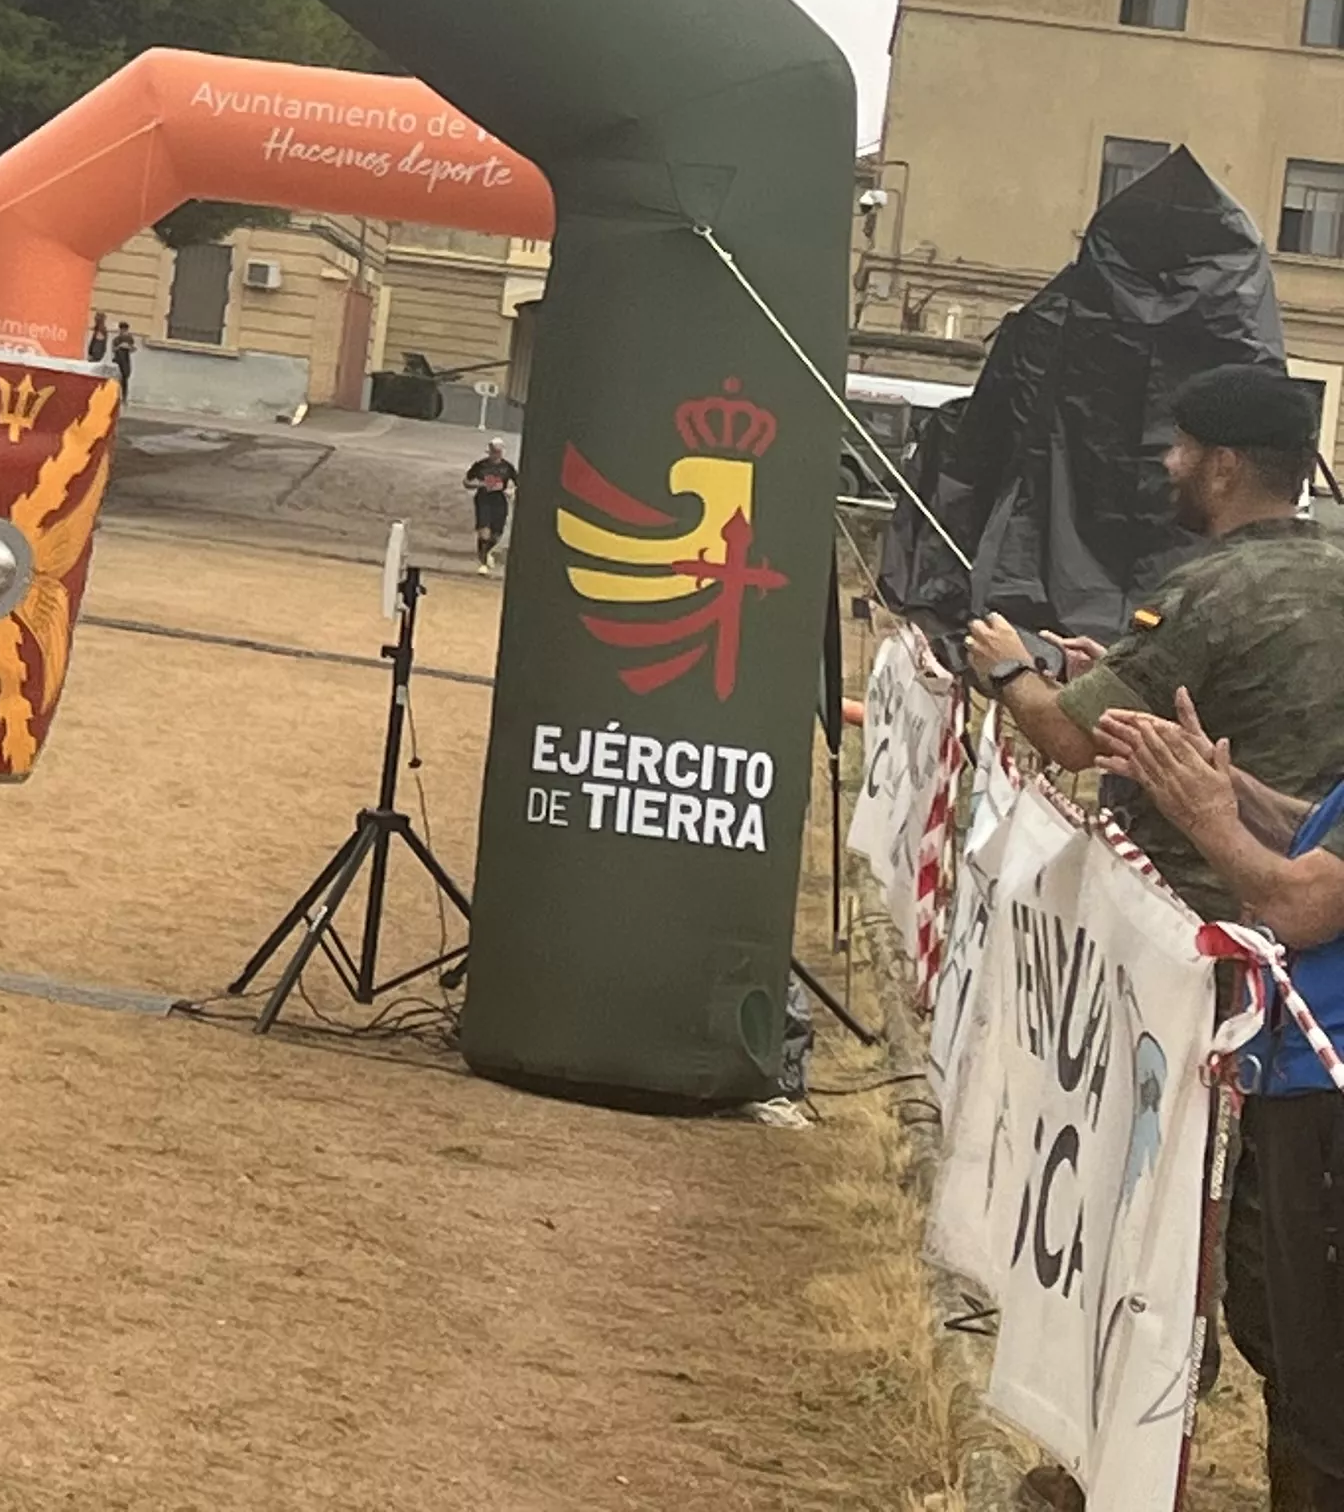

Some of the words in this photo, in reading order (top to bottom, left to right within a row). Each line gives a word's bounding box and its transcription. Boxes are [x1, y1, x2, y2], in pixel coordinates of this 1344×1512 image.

[190, 80, 418, 135] Ayuntamiento
[427, 112, 467, 140] de
[261, 126, 392, 178] Hacemos
[397, 140, 512, 193] deporte
[532, 720, 774, 799] EJÉRCITO
[527, 786, 572, 827] DE
[581, 781, 767, 852] TIERRA
